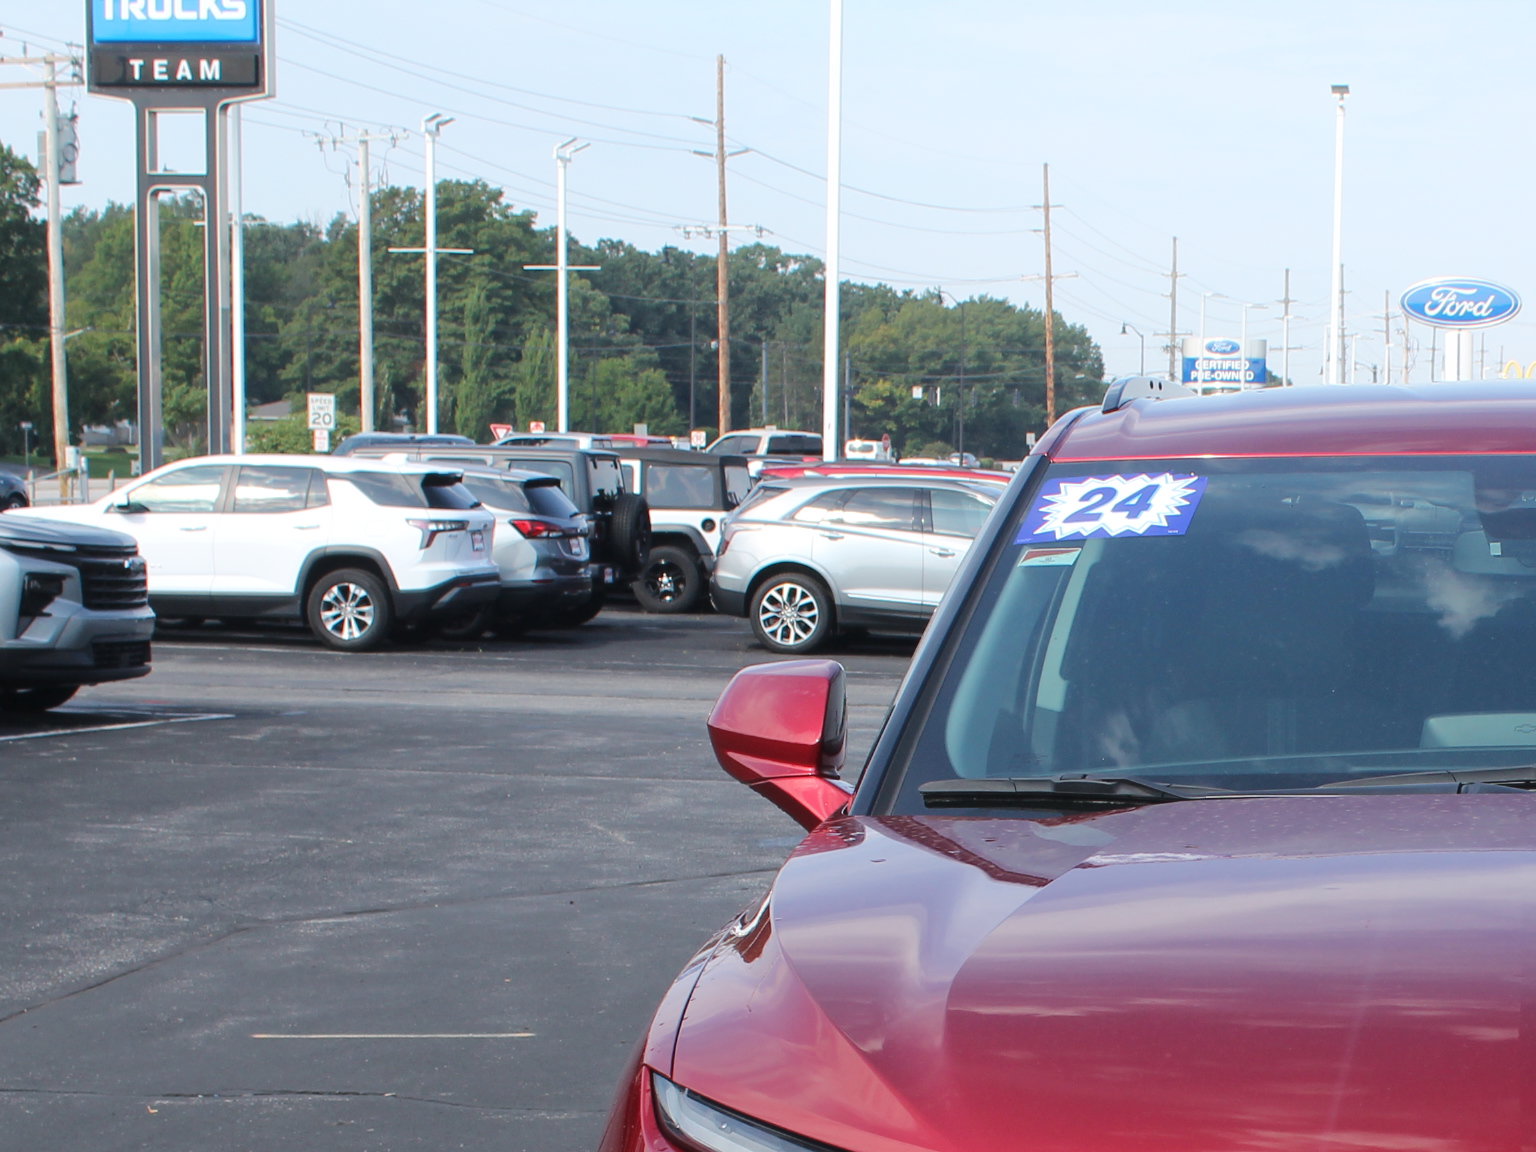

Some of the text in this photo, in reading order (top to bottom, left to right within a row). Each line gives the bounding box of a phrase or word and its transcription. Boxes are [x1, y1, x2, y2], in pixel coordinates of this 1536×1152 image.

[129, 59, 220, 80] TEAM
[1424, 286, 1496, 316] Ford
[311, 412, 332, 425] 20
[1062, 484, 1161, 524] 24
